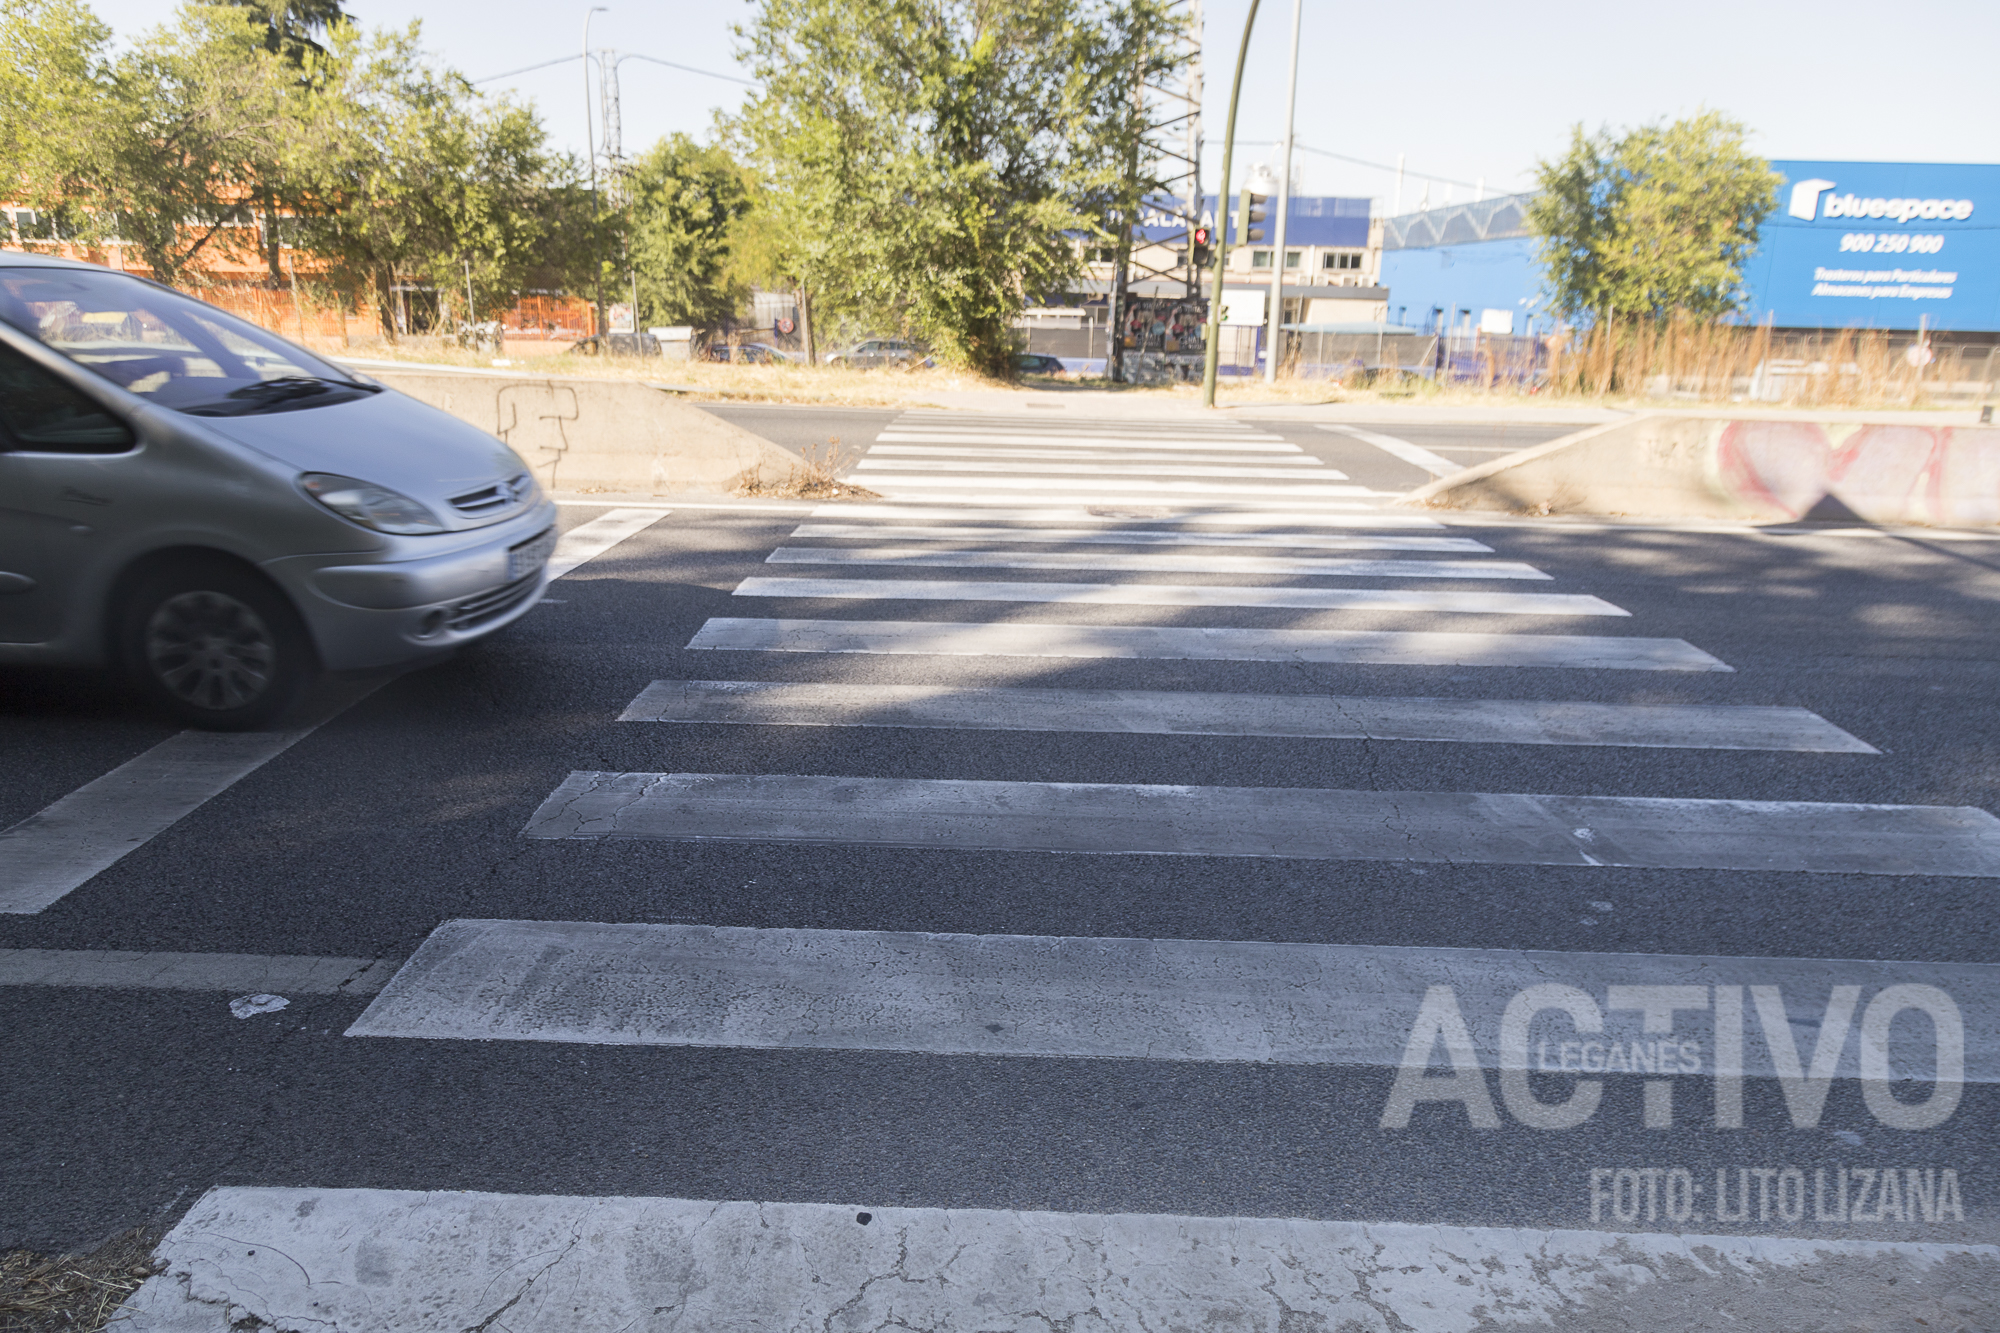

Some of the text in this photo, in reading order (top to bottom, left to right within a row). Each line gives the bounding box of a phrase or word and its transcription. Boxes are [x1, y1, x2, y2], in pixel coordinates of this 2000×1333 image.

[1823, 193, 1974, 223] bluespace
[1839, 233, 1945, 254] 900 250 900
[1861, 270, 1892, 285] para
[1869, 285, 1900, 300] para
